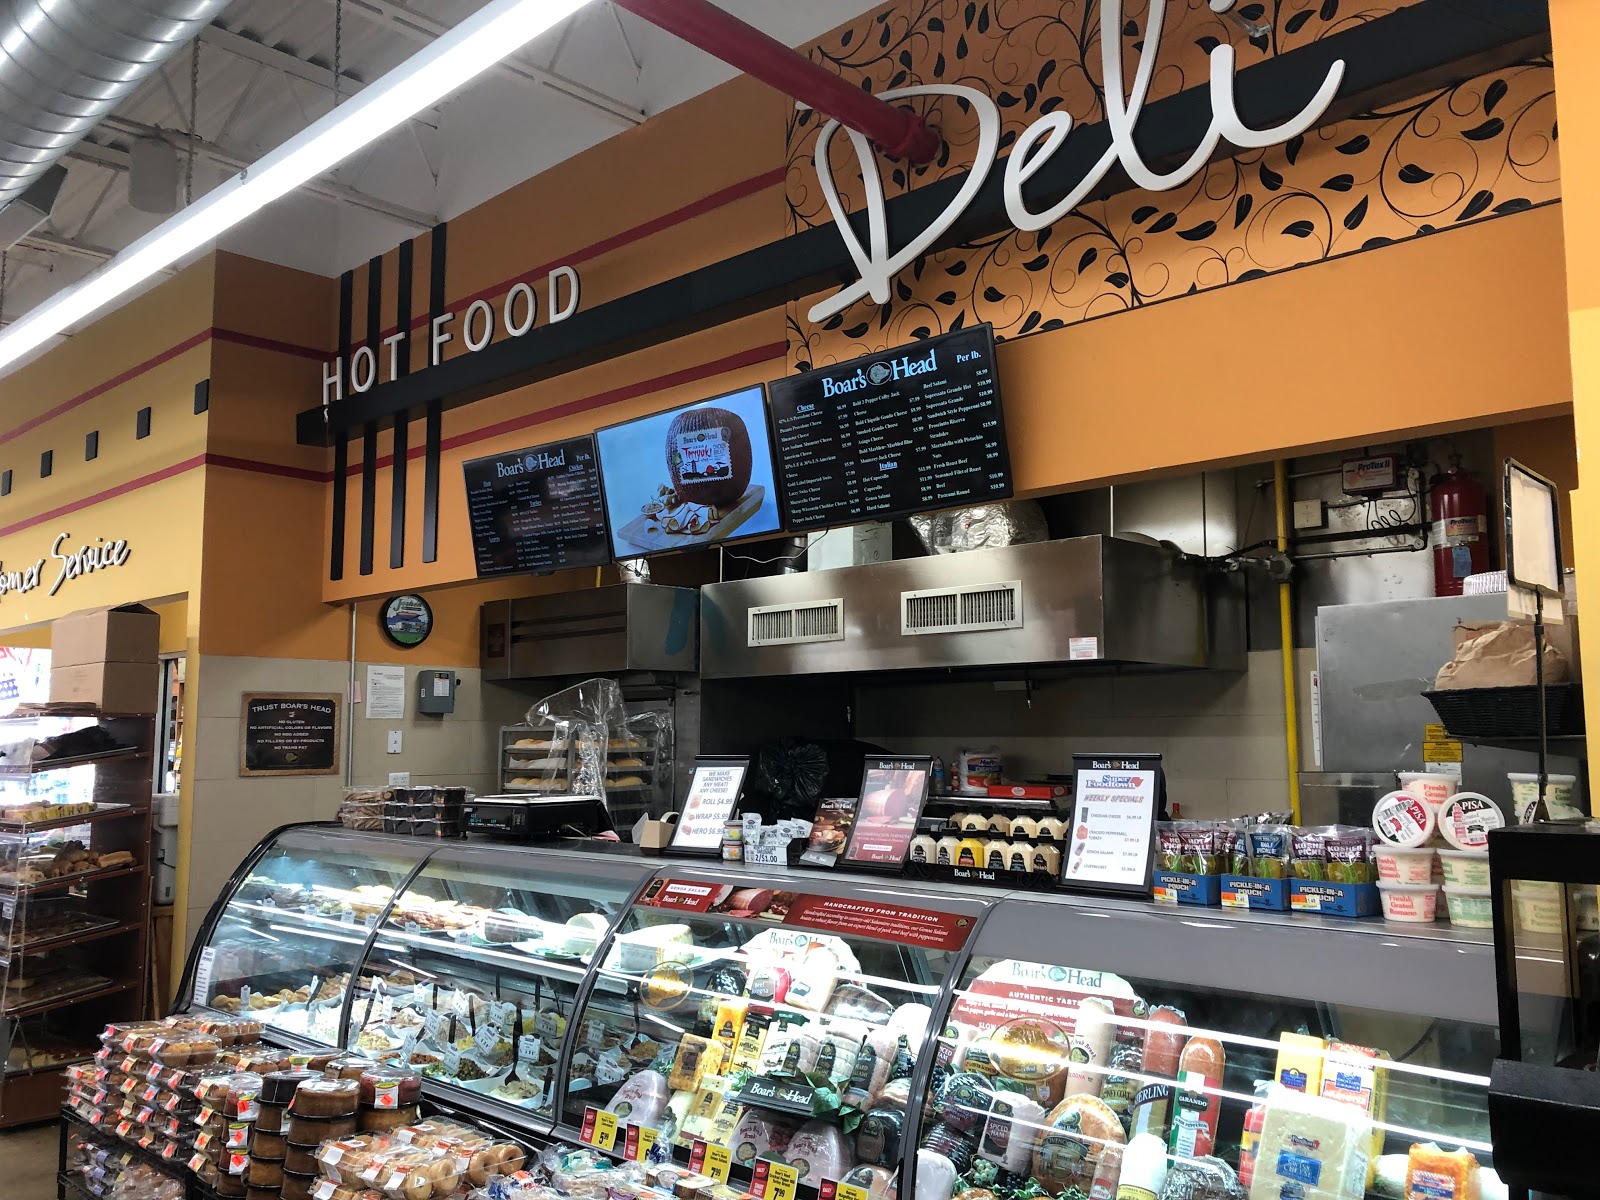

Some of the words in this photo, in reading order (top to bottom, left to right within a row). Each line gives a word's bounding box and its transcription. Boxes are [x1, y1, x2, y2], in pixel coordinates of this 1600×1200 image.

[796, 0, 1346, 323] Deli
[323, 331, 405, 405] HOT
[432, 265, 579, 366] FOOD
[957, 354, 969, 363] Per
[971, 351, 981, 359] lb.
[822, 369, 867, 398] Boar's
[891, 349, 937, 381] Head
[797, 404, 815, 413] Cheese
[497, 458, 524, 478] Boar's
[538, 449, 565, 469] Head
[879, 462, 897, 471] Italian
[49, 532, 132, 596] Service
[252, 704, 278, 713] TRUST
[310, 705, 331, 714] HEAD
[901, 762, 915, 770] Head
[1092, 761, 1111, 769] Boar's
[1121, 761, 1139, 769] Head
[1103, 775, 1131, 783] Super
[1086, 780, 1136, 789] Foodtown
[1111, 795, 1144, 803] SPECIALS
[1462, 800, 1484, 810] PISA
[1410, 806, 1426, 825] PISA
[954, 869, 970, 878] Boar's
[1161, 877, 1196, 886] PICKLE-IN-A
[1230, 882, 1270, 891] PICKLE-IN-A
[1300, 887, 1343, 897] PICKLE-IN-A
[662, 895, 678, 903] Boar's
[683, 898, 700, 906] Head
[824, 902, 875, 913] HANDCRAFTED
[898, 912, 938, 922] TRADITION
[1012, 962, 1046, 981] Boar's
[1068, 969, 1102, 988] Head
[1009, 991, 1053, 1003] AUTHENTIC
[750, 1083, 776, 1097] Boar's
[788, 1089, 812, 1105] Head
[1179, 1096, 1207, 1107] CARANDO
[990, 1123, 1008, 1133] SPICED
[991, 1129, 1005, 1139] HAM
